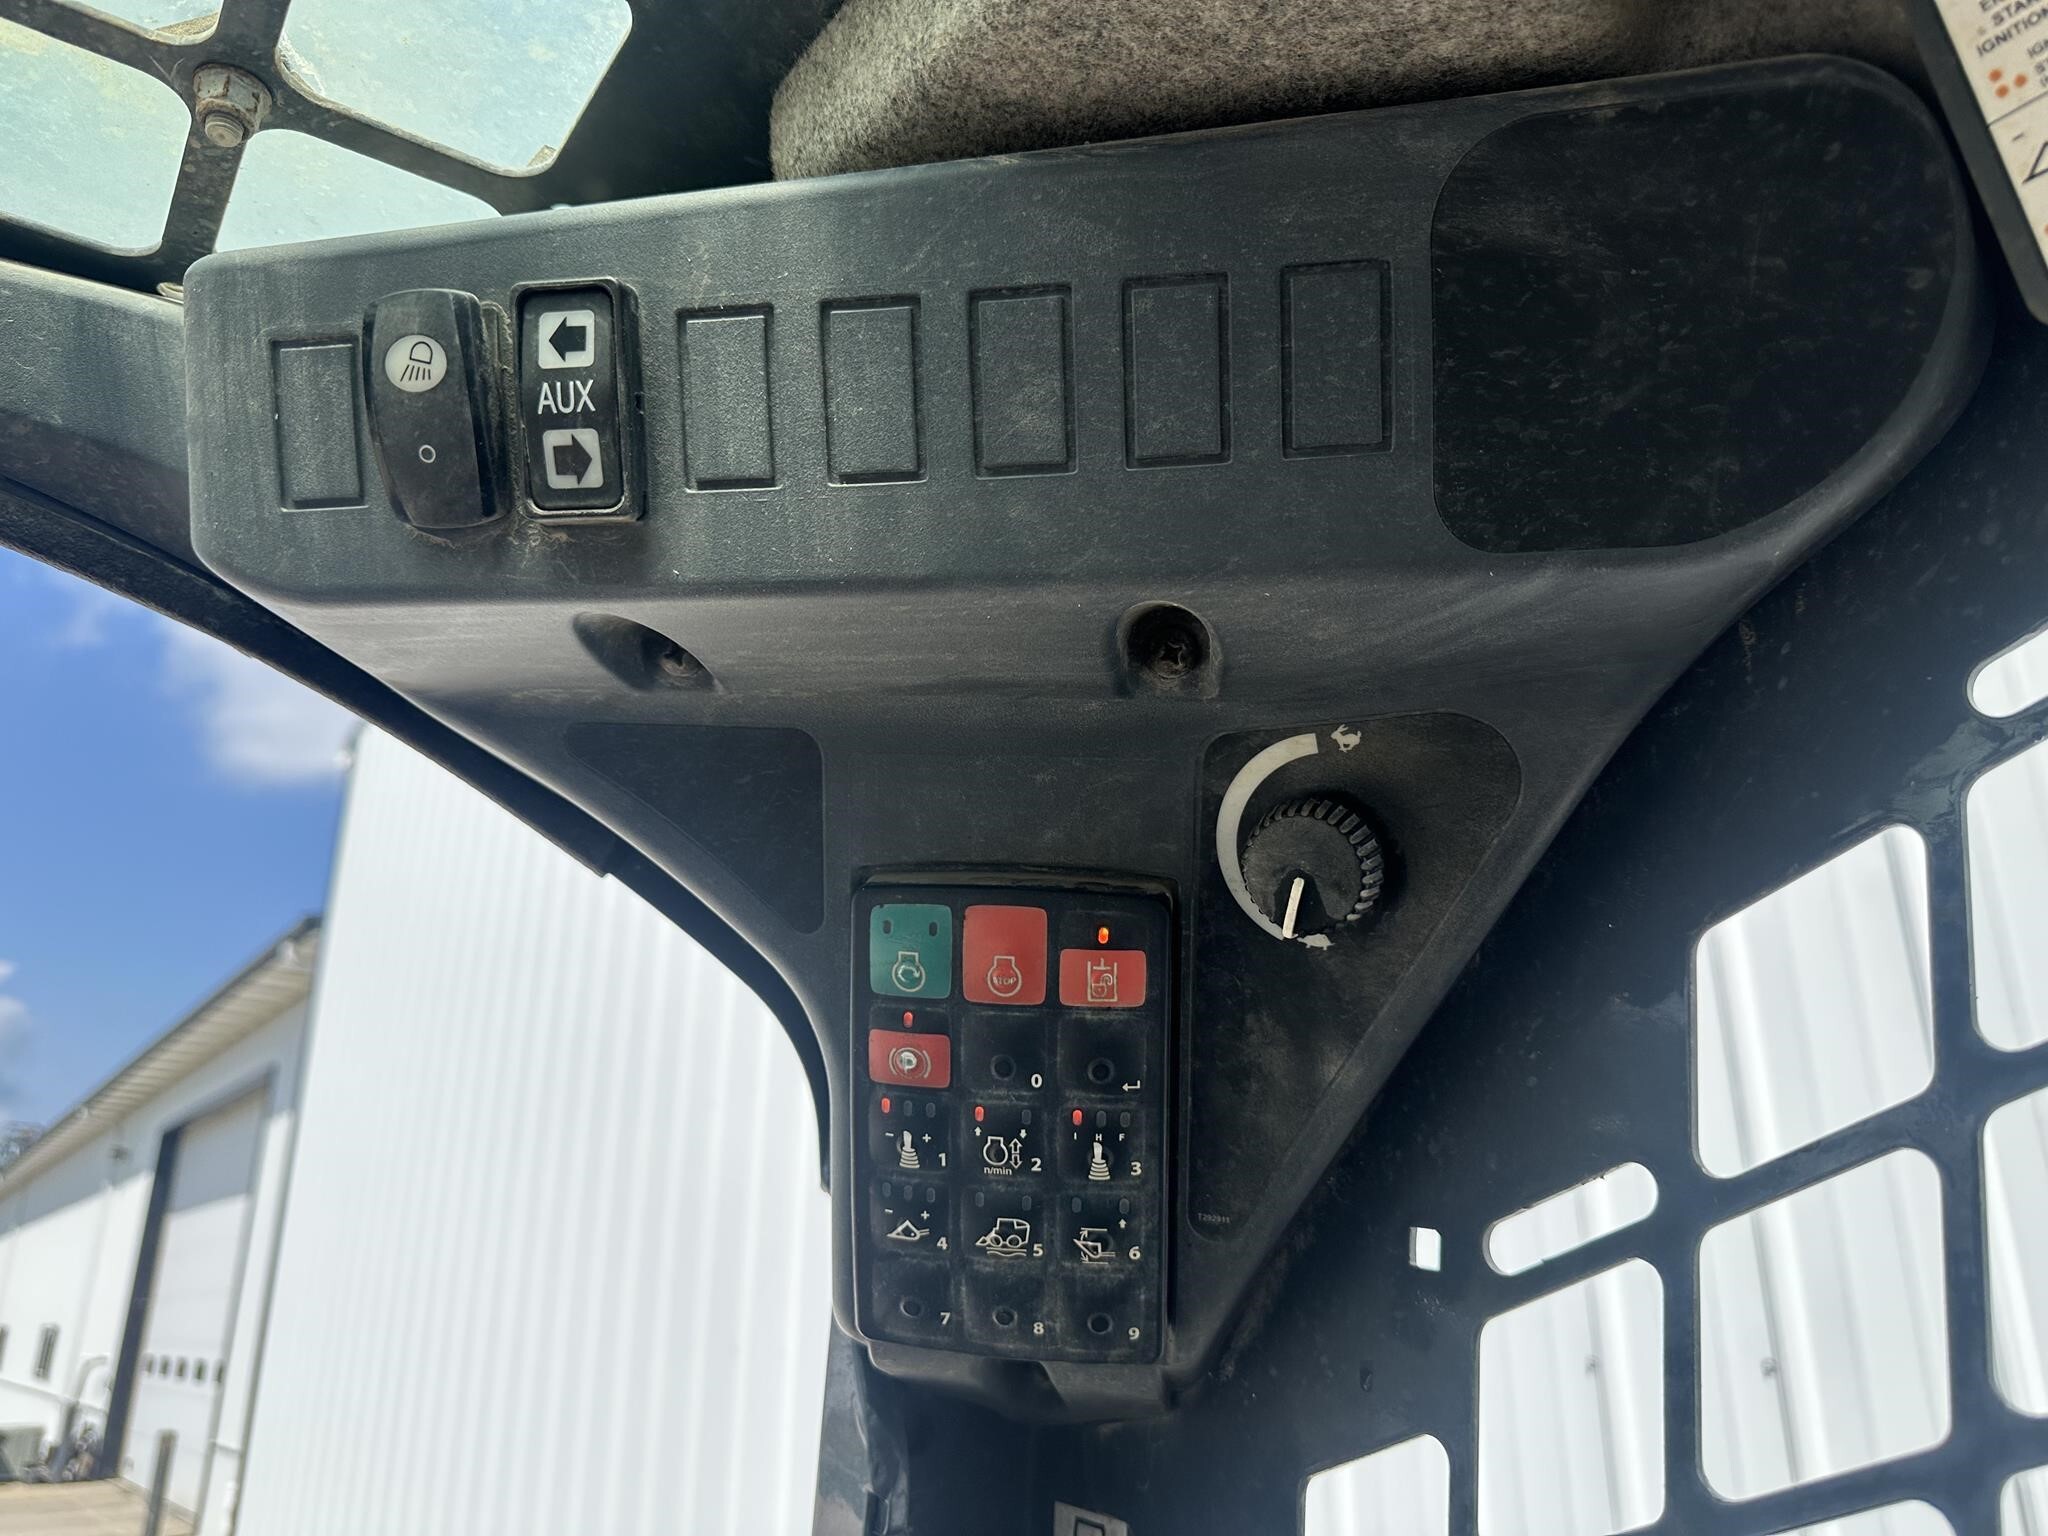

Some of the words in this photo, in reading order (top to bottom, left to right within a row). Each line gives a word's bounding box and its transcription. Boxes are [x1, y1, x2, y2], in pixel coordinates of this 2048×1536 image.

[537, 379, 596, 415] AUX
[992, 975, 1018, 986] STOP
[1030, 1073, 1043, 1089] 0
[1095, 1133, 1103, 1142] H
[1118, 1133, 1126, 1142] F
[938, 1152, 947, 1167] 1
[1031, 1158, 1042, 1172] 2
[983, 1165, 1012, 1176] n/min
[1130, 1162, 1142, 1175] 3
[936, 1236, 949, 1251] 4
[1032, 1243, 1044, 1257] 5
[1129, 1246, 1141, 1260] 6
[940, 1312, 951, 1325] 7
[1033, 1322, 1044, 1336] 8
[1128, 1327, 1140, 1340] 9
